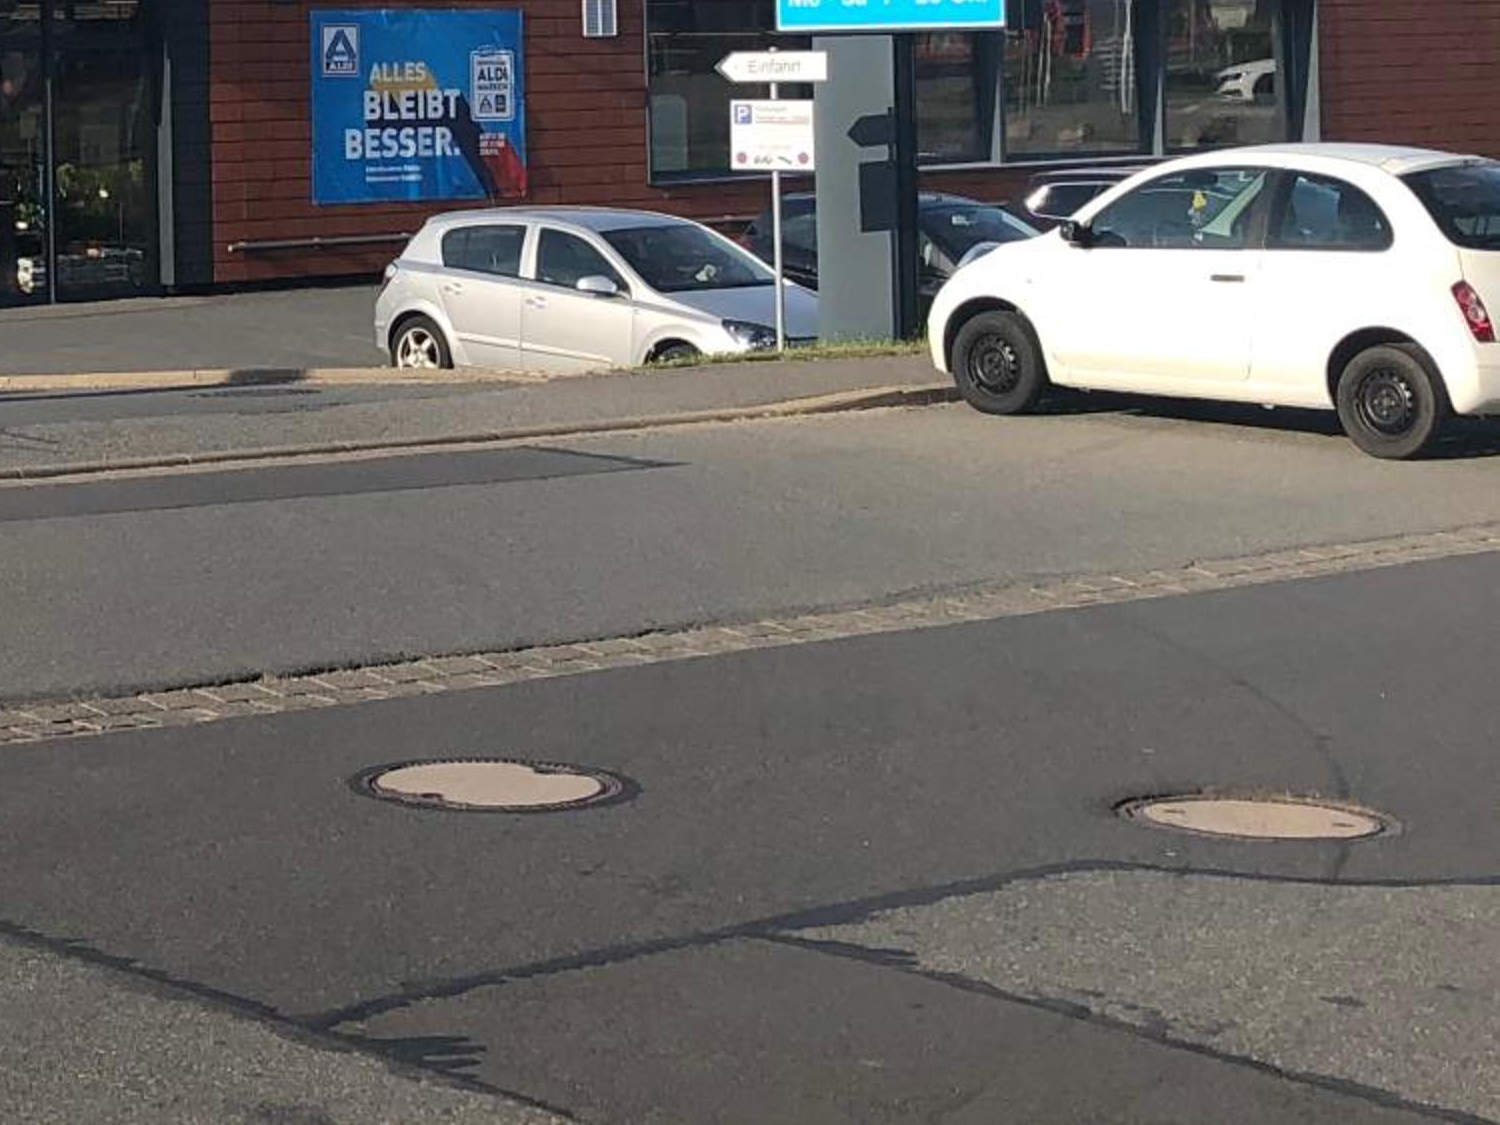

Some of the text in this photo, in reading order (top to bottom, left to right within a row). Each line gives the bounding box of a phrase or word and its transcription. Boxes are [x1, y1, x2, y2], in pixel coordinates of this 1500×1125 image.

[369, 61, 427, 84] ALLES
[747, 58, 803, 74] Einfahrt
[363, 88, 462, 121] BLEIBT
[345, 126, 462, 160] BESSER.
